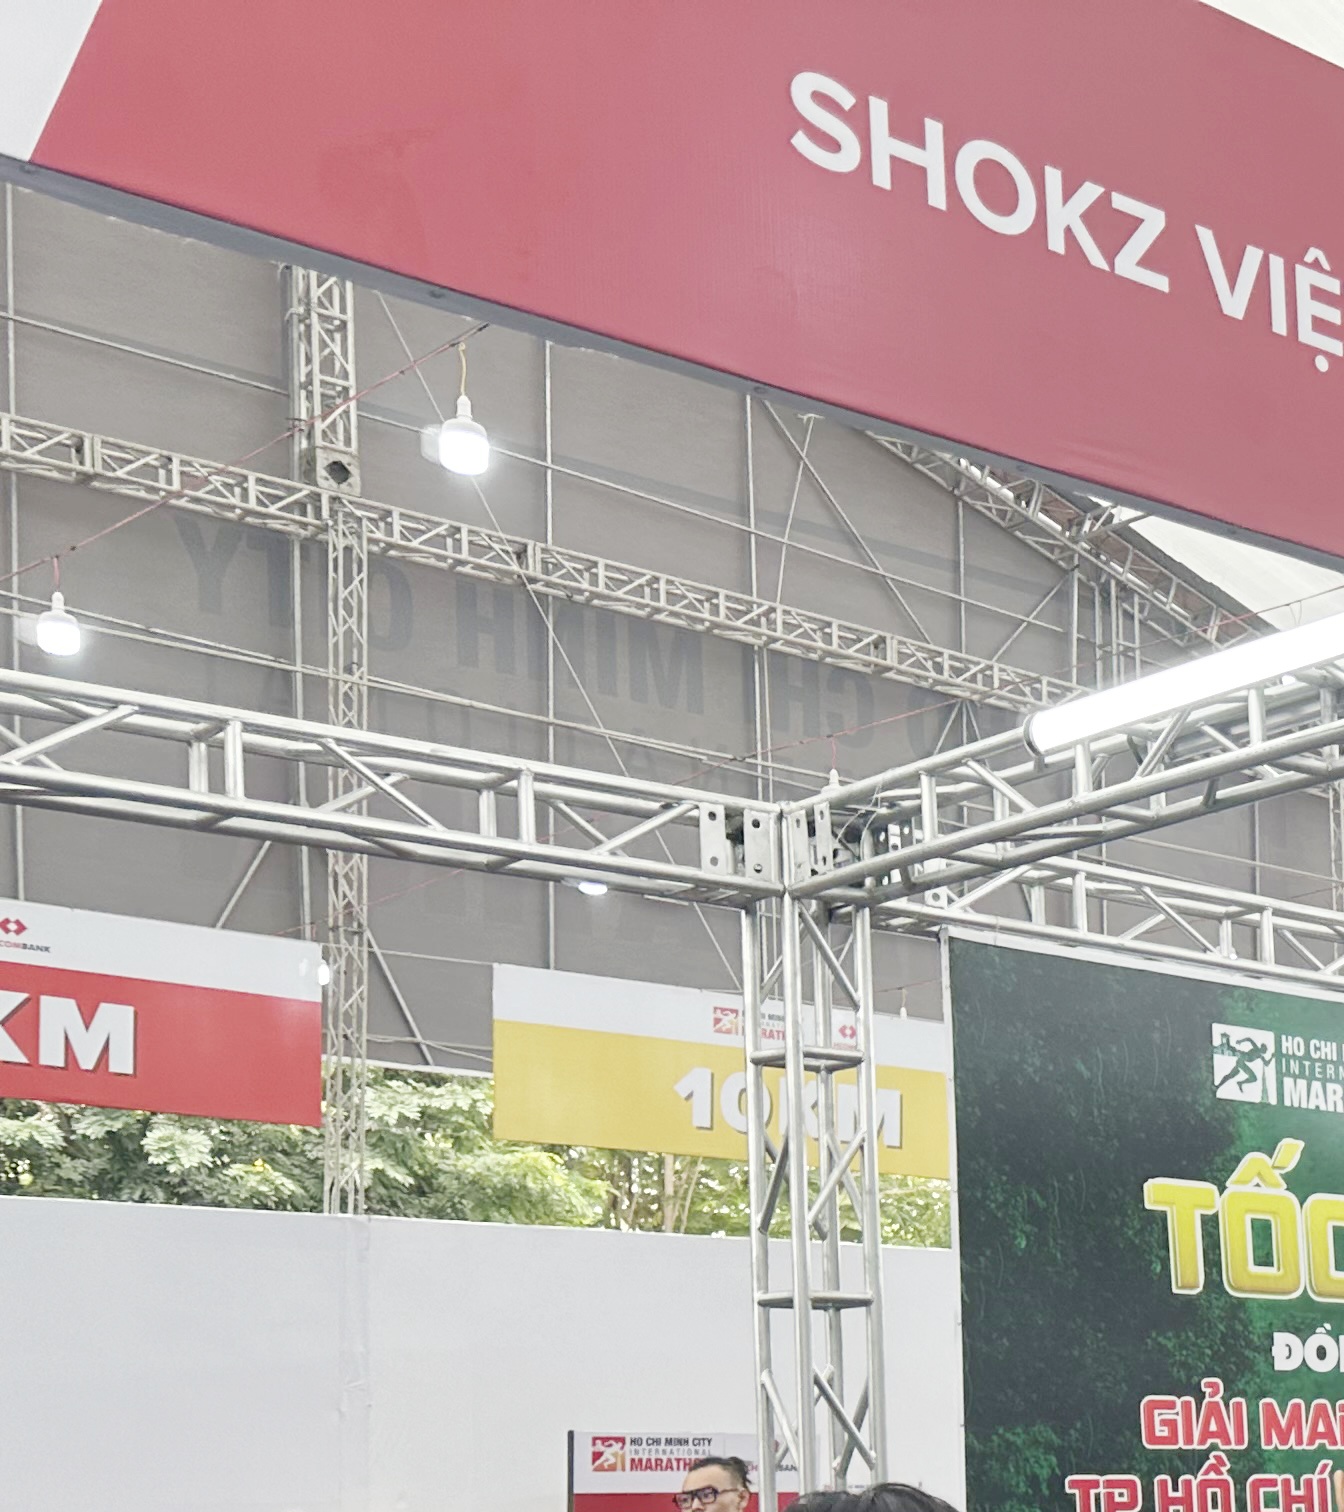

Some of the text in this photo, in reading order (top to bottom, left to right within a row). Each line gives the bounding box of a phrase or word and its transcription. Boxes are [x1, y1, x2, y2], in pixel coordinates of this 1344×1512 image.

[789, 71, 1170, 294] SHOKZ
[1281, 1034, 1306, 1057] HO
[1309, 1037, 1339, 1062] CHI
[1140, 1376, 1249, 1451] GIẢI
[692, 1437, 713, 1447] CITY
[629, 1457, 701, 1472] MARATH
